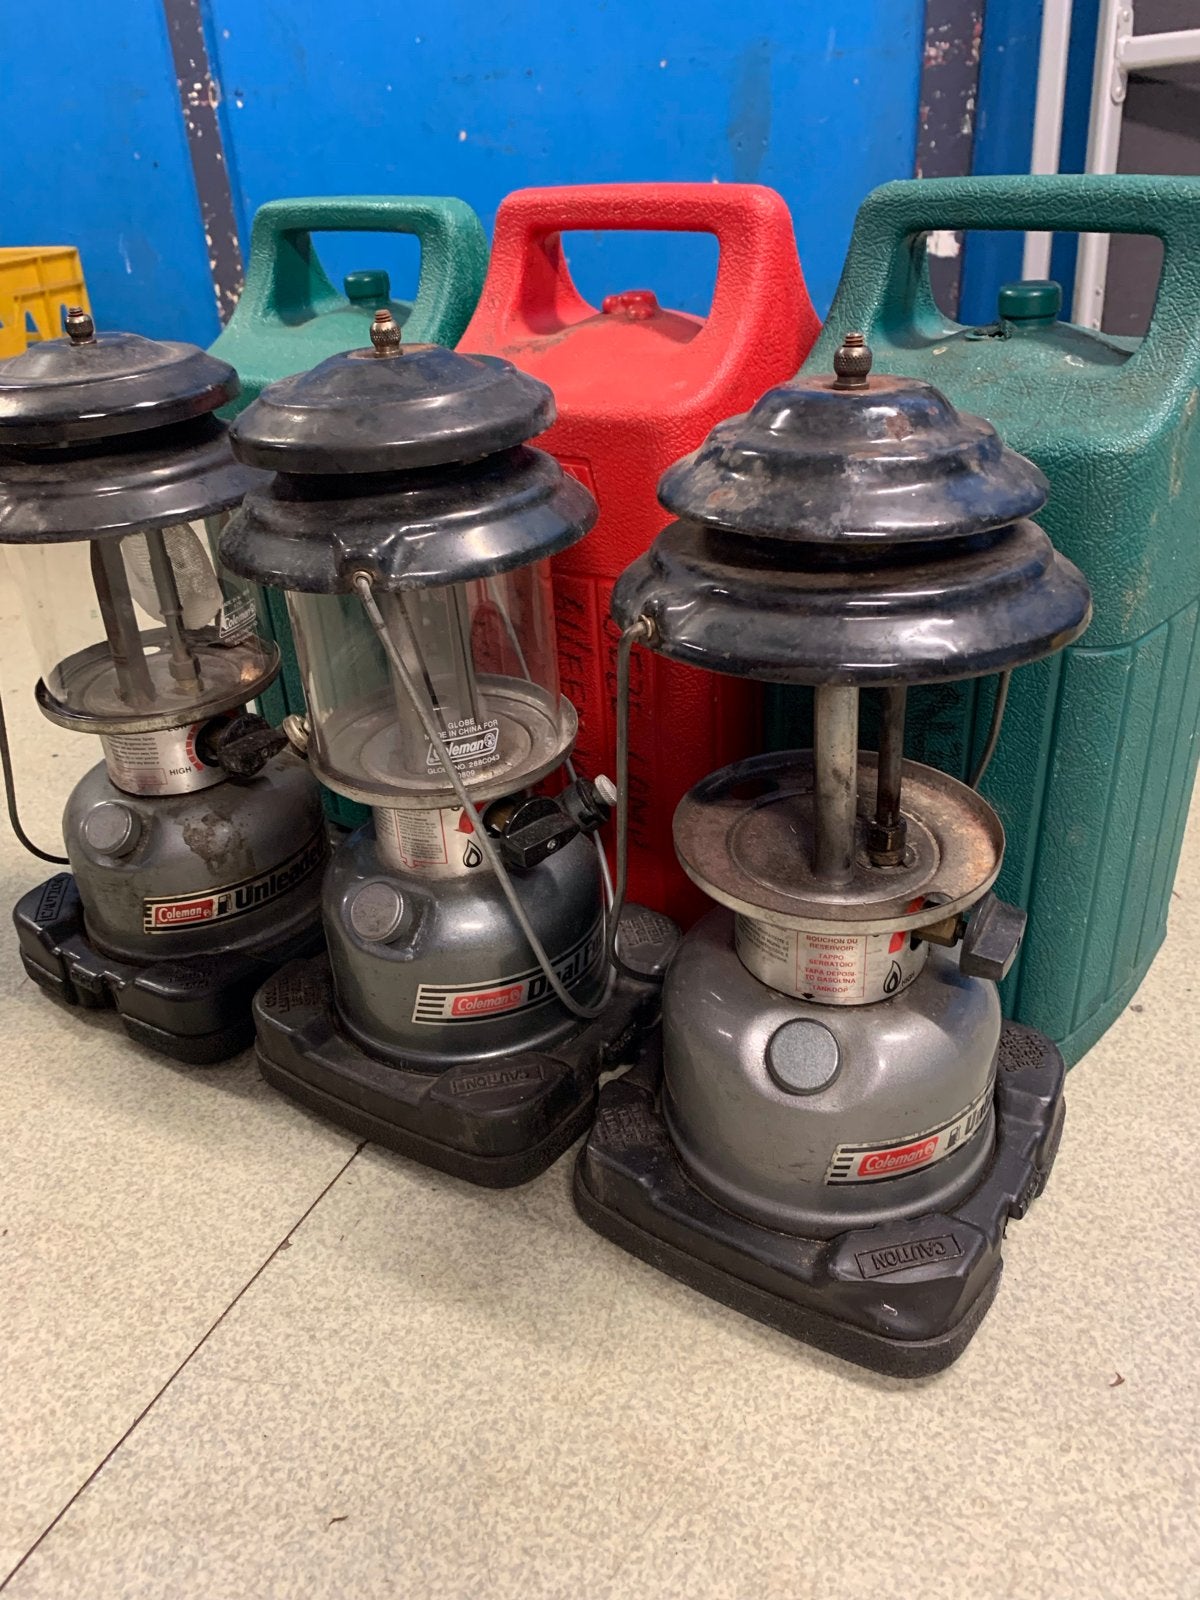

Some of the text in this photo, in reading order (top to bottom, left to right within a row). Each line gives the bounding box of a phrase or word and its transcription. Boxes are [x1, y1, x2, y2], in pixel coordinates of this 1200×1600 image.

[447, 717, 475, 730] GLOBE
[448, 729, 457, 737] IN
[458, 724, 483, 736] CHINA
[483, 719, 499, 729] FOR
[433, 739, 484, 761] leman
[169, 766, 192, 776] HIGH
[159, 906, 202, 922] Coleman
[806, 935, 845, 944] BOUCHON
[809, 943, 854, 951] RESERVOIR
[817, 976, 856, 984] GASOLINA
[457, 995, 508, 1012] Coleman
[465, 1069, 530, 1090] CAUTION
[866, 1149, 923, 1171] Coleman
[872, 1240, 947, 1270] CAUTION
